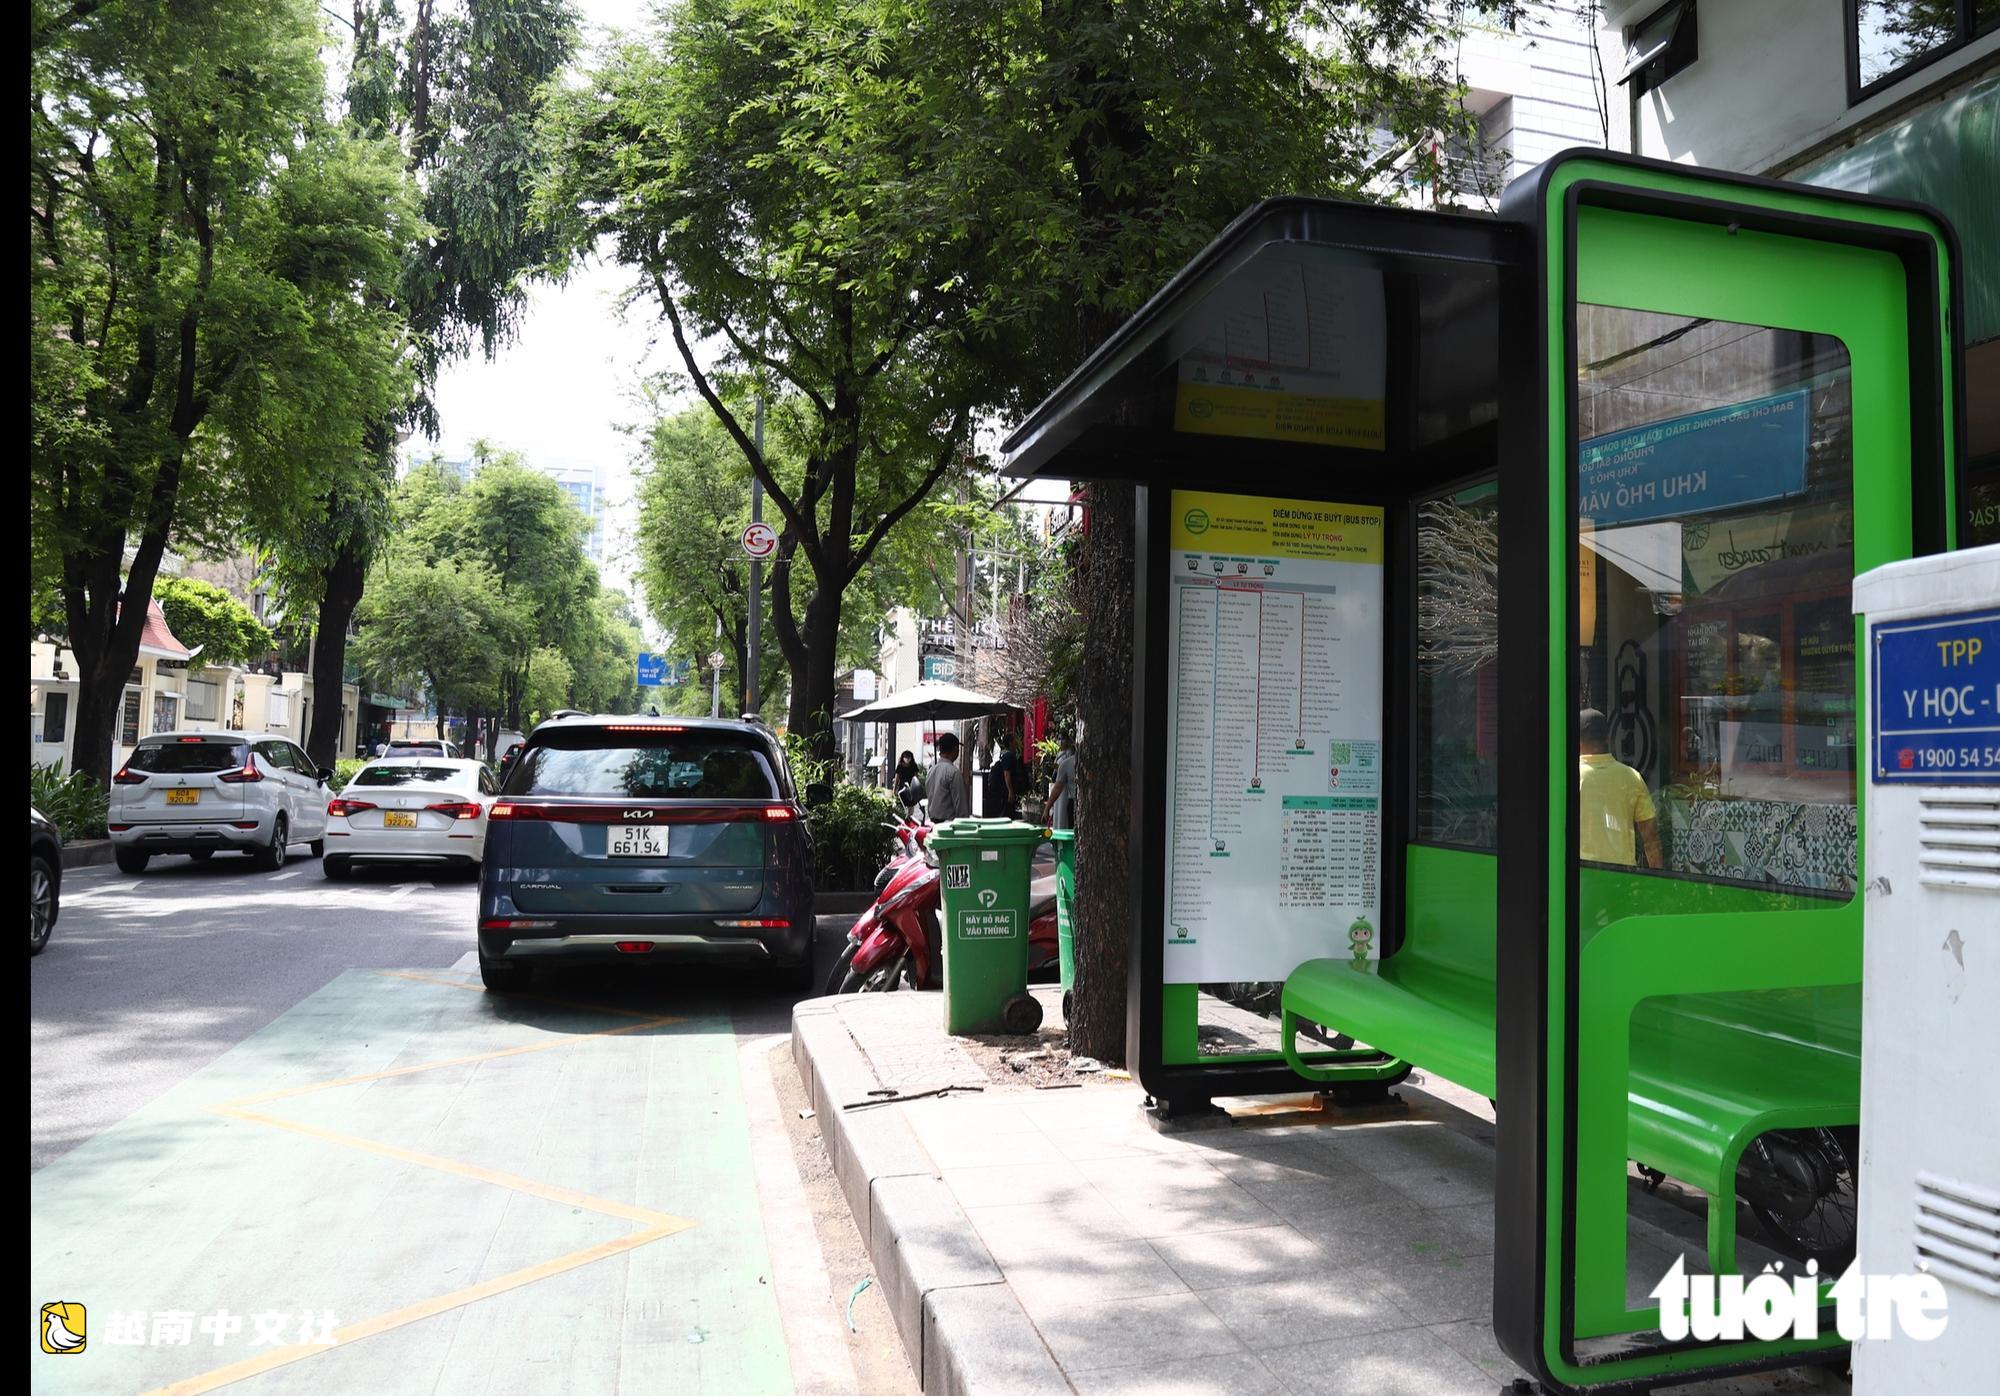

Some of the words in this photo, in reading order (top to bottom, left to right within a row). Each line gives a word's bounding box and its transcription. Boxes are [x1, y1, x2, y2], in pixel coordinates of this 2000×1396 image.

[1273, 508, 1290, 519] ĐIỂM
[1291, 508, 1312, 521] DỪNG
[1313, 511, 1322, 521] XE
[1324, 512, 1342, 523] BUÝT
[1343, 514, 1360, 525] (BUS
[1361, 516, 1381, 528] STOP)
[1303, 531, 1311, 540] LÝ
[1322, 534, 1343, 543] TRỌNG
[1937, 638, 1982, 667] TPP
[1903, 689, 1918, 718] Y
[1923, 685, 1975, 724] HỌC
[1918, 748, 1956, 768] 1900
[1960, 748, 1979, 768] 54
[625, 827, 650, 840] 51K
[613, 841, 661, 854] 661.94
[982, 914, 993, 925] BỎ
[994, 914, 1010, 924] RÁC
